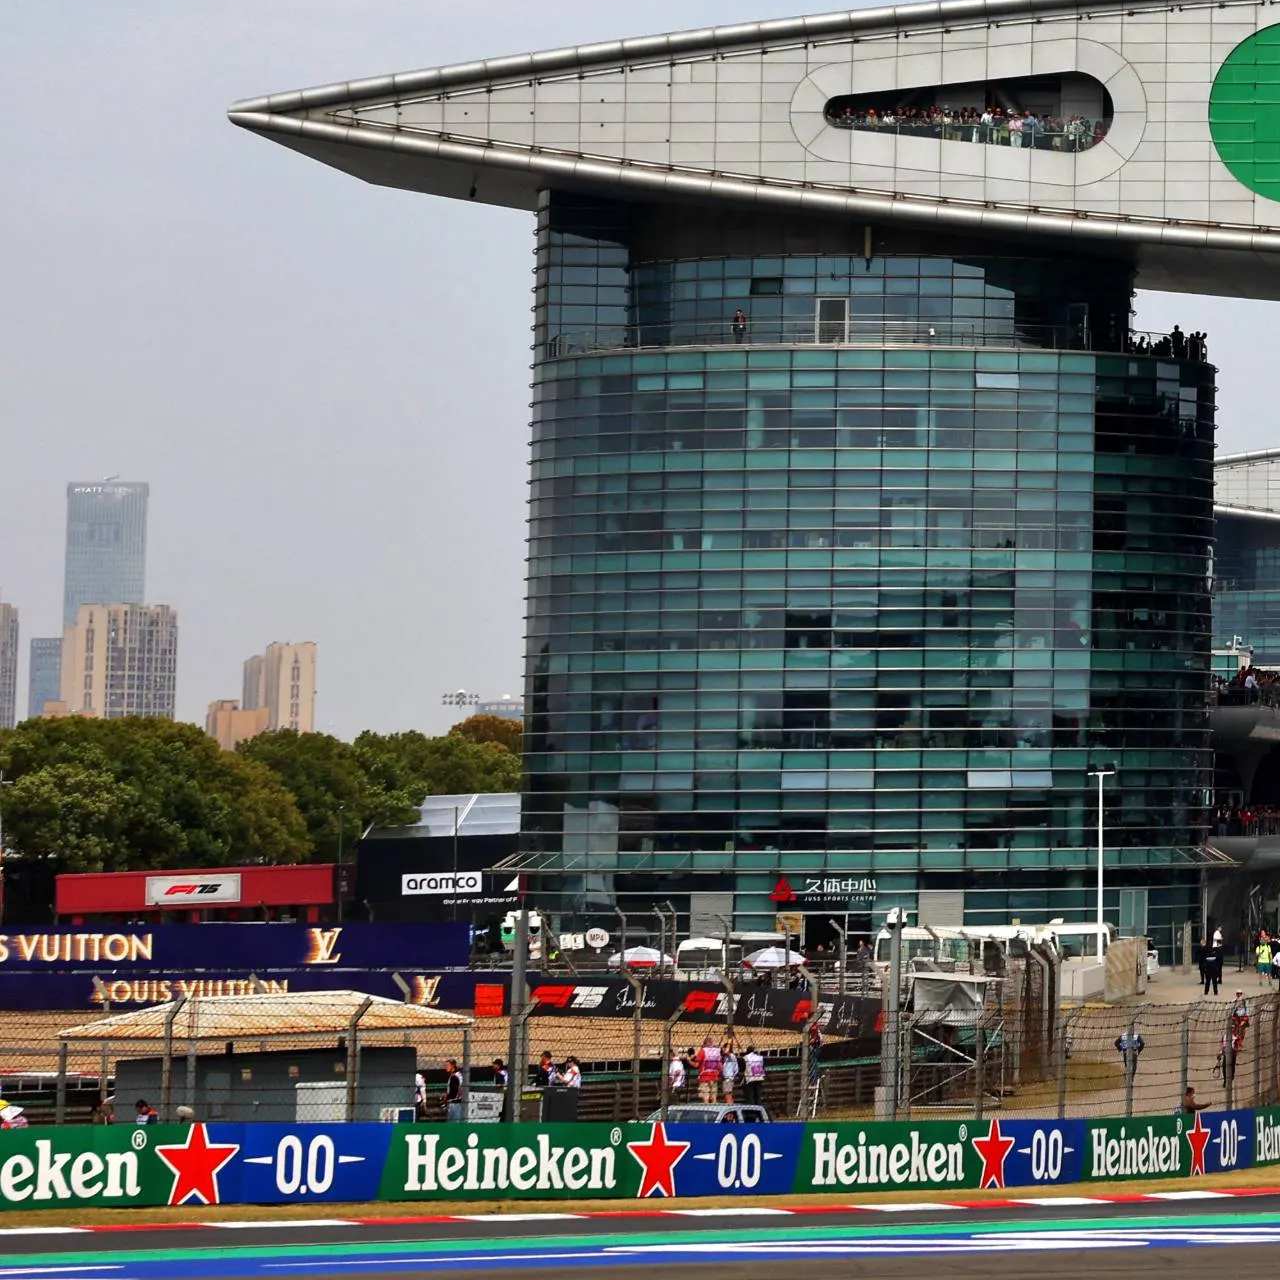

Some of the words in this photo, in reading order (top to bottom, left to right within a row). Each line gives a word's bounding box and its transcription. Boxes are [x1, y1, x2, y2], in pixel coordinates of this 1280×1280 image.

[407, 877, 477, 889] aramco
[19, 933, 152, 961] VUITTON
[275, 1135, 334, 1195] 0.0
[718, 1134, 761, 1188] 0.0
[1031, 1129, 1062, 1180] 0.0
[1220, 1120, 1238, 1166] 0.0
